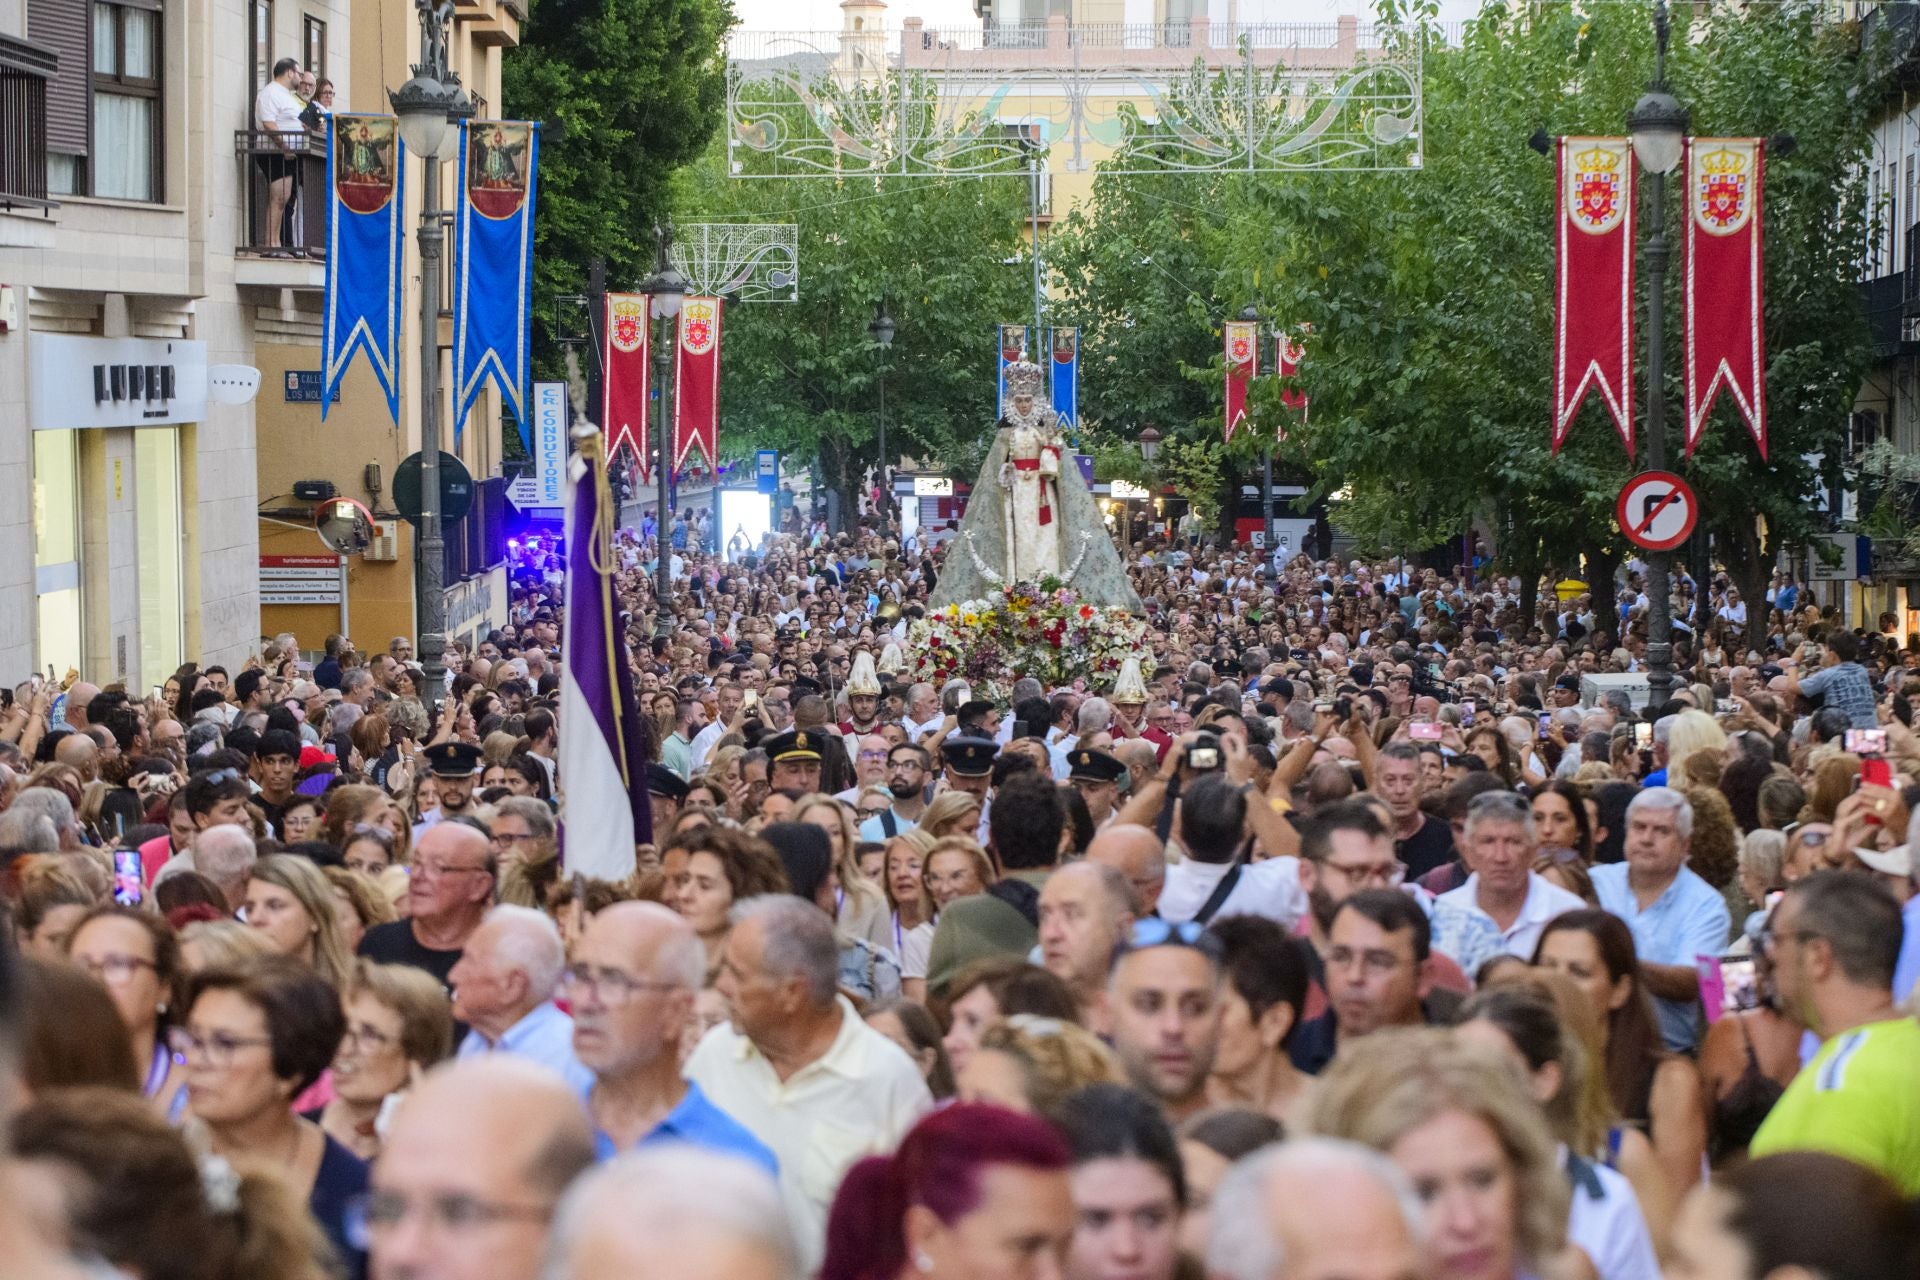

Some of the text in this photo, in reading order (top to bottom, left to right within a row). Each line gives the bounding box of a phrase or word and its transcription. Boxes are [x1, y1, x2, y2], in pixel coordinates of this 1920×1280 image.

[93, 365, 176, 404] LUPER
[213, 379, 252, 387] LUPER
[286, 391, 303, 400] LOS
[543, 409, 558, 501] CONDUCTORES
[1256, 532, 1289, 545] Sle
